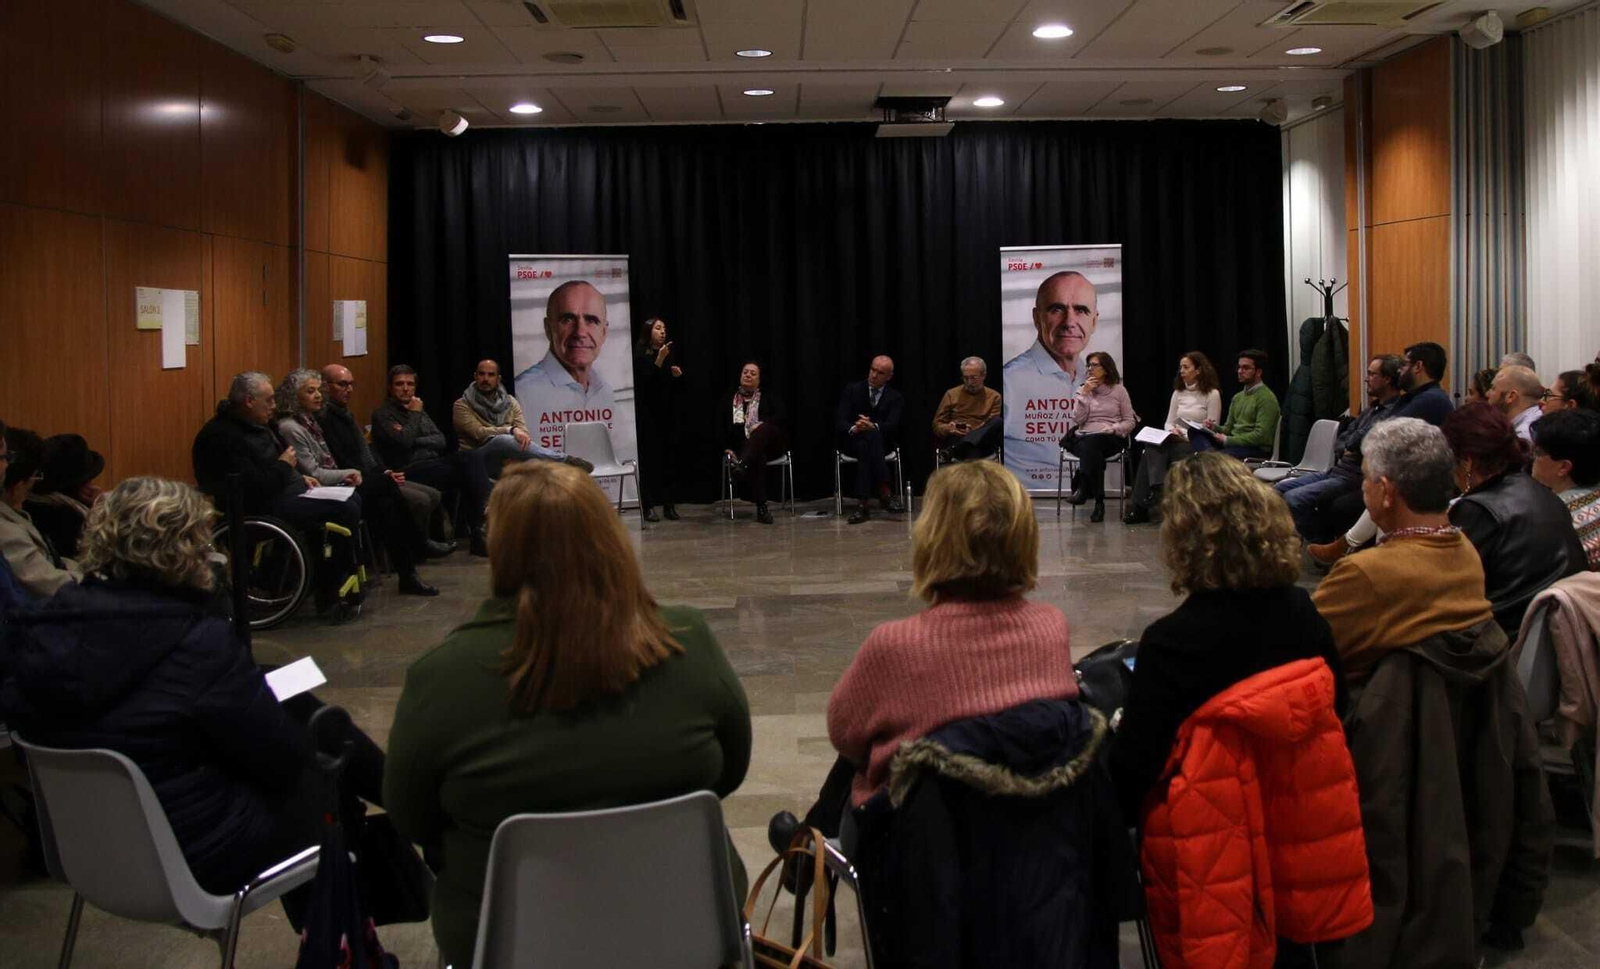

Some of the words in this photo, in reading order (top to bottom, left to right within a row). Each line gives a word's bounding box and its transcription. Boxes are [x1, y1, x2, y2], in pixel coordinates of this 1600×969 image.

[517, 271, 537, 279] PSOE
[1025, 399, 1075, 410] ANTO
[540, 409, 612, 423] ANTONIO
[540, 424, 565, 432] MUÑO
